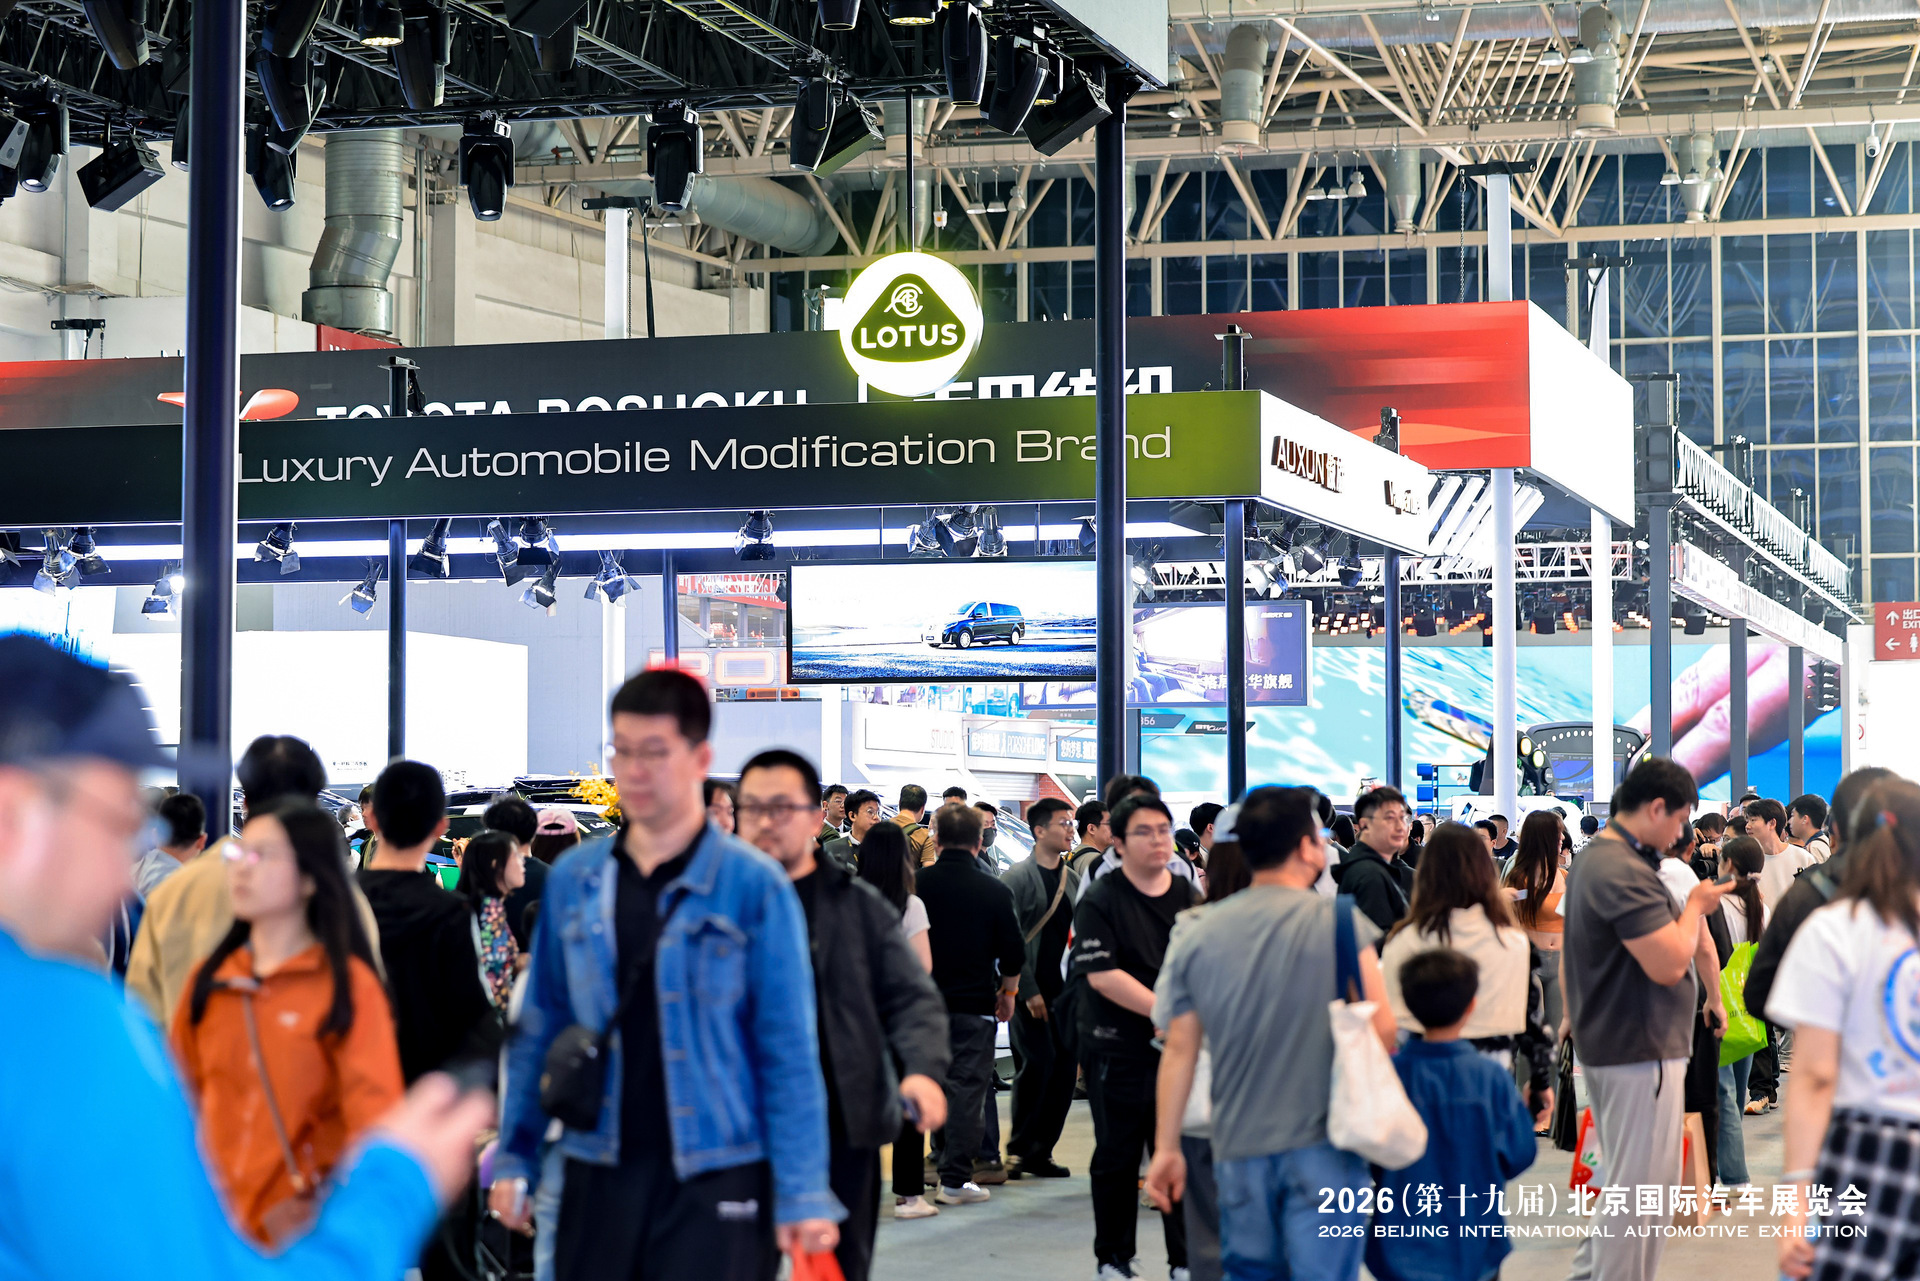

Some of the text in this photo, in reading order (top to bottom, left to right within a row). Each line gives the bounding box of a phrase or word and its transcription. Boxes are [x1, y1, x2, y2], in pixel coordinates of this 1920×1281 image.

[860, 323, 958, 350] LOTUS
[238, 452, 393, 487] Luxury
[405, 439, 670, 480] Automobile
[690, 432, 995, 471] Modification
[1271, 435, 1328, 485] AUXUN
[1902, 608, 1920, 620] 出口
